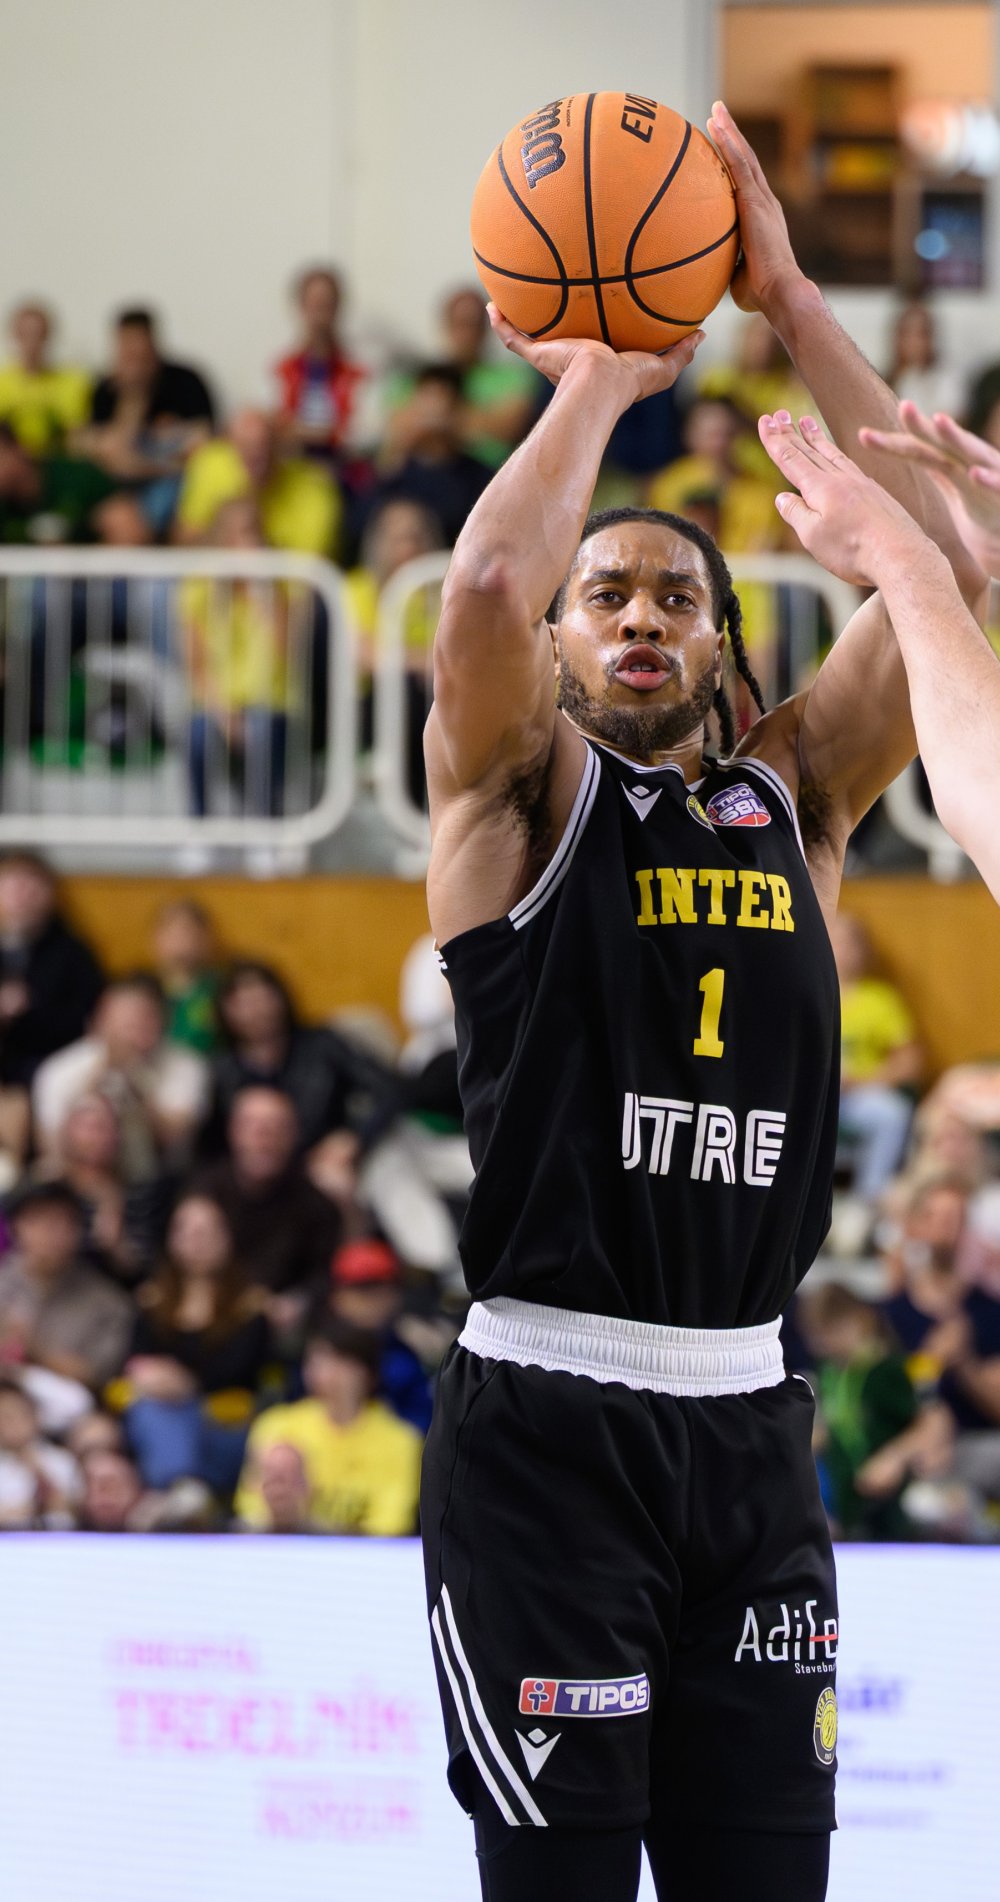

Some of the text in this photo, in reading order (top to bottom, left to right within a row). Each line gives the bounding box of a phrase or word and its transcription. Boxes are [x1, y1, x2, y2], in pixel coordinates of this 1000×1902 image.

[718, 798, 768, 824] SBL
[635, 868, 794, 932] INTER
[693, 968, 725, 1058] 1
[564, 1679, 648, 1711] TIPOS
